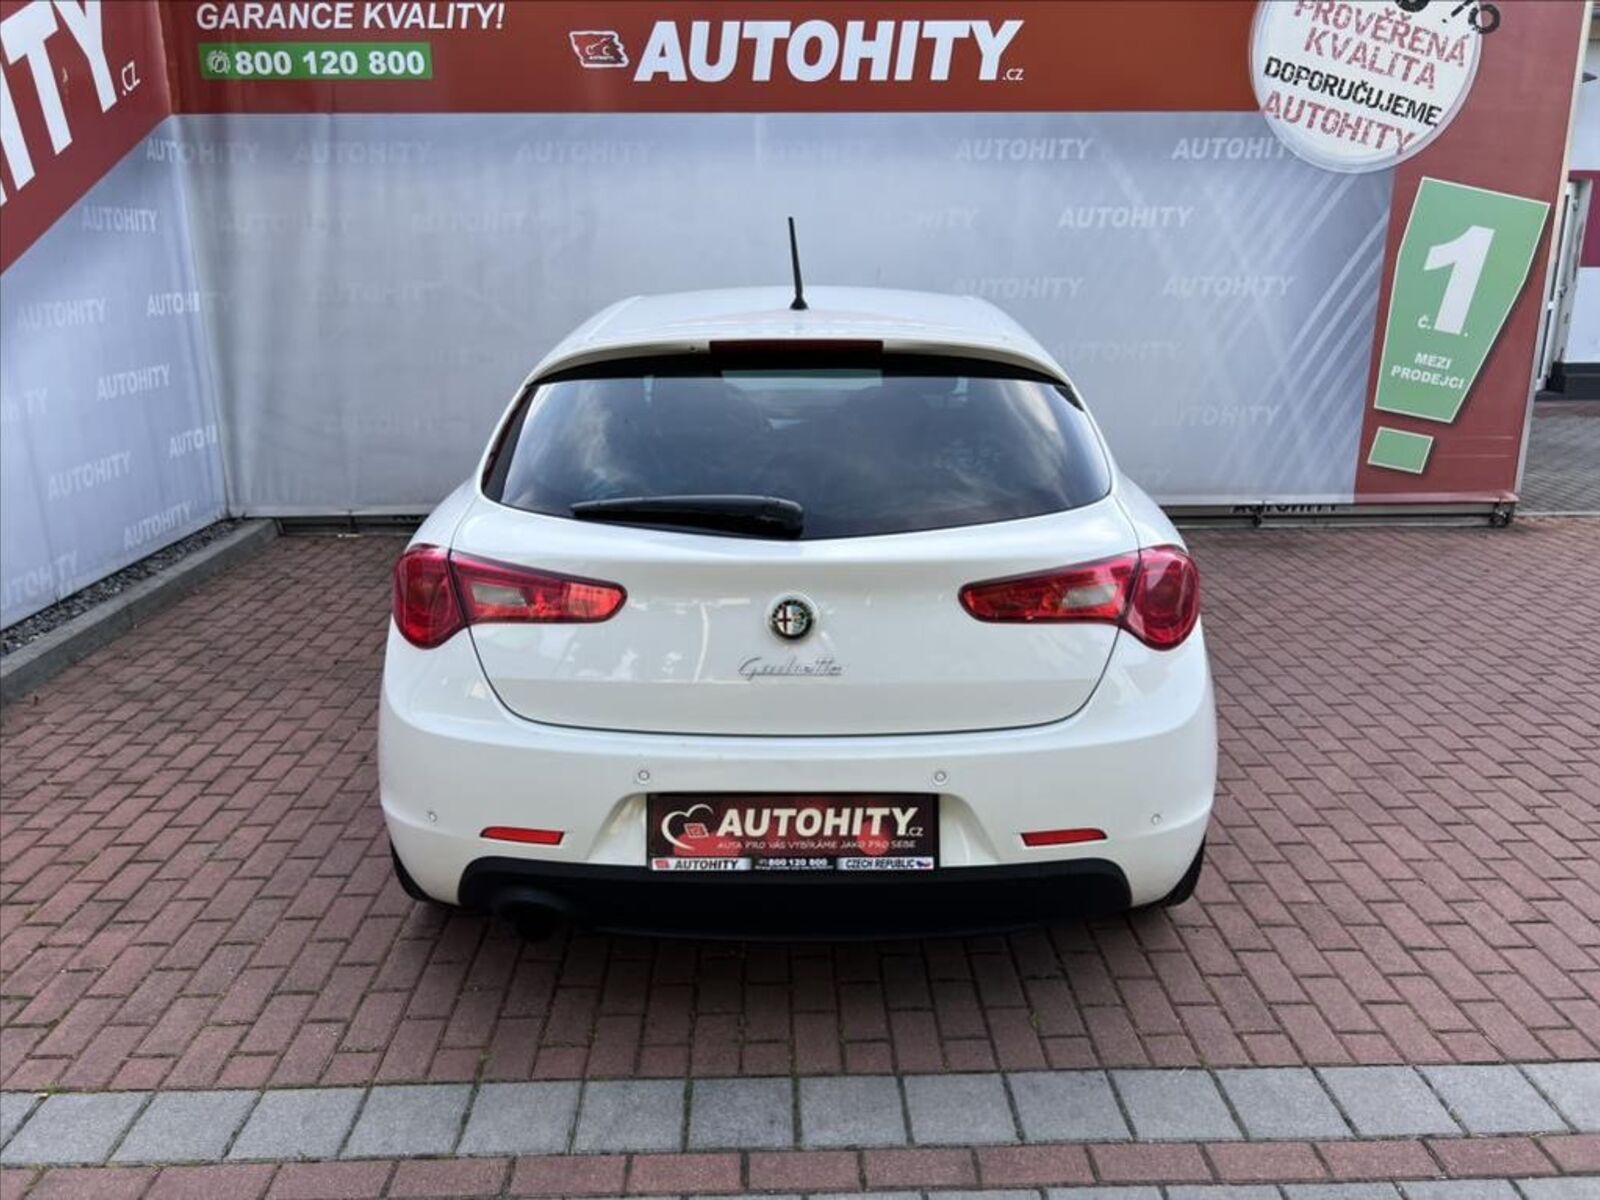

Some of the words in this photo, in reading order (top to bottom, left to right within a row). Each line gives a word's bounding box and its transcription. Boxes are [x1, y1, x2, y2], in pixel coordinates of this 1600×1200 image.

[196, 3, 353, 29] GARANCE
[363, 3, 505, 29] KVALITY!
[235, 50, 292, 75] 800
[303, 50, 358, 75] 120
[368, 50, 425, 75] 800
[1305, 27, 1436, 90] KVALITA
[1264, 57, 1443, 127] DOPORUČUJEME
[1263, 91, 1416, 154] AUTOHITY
[955, 137, 1092, 161] AUTOHITY
[1057, 205, 1195, 230] AUTOHITY
[1414, 352, 1452, 371] MEZI
[1390, 365, 1465, 389] PRODEJCI
[744, 840, 766, 850] PRO
[867, 839, 890, 849] PRO
[674, 859, 738, 870] AUTOHITY
[845, 858, 873, 869] CZECH
[875, 858, 915, 869] REPUBLIC
